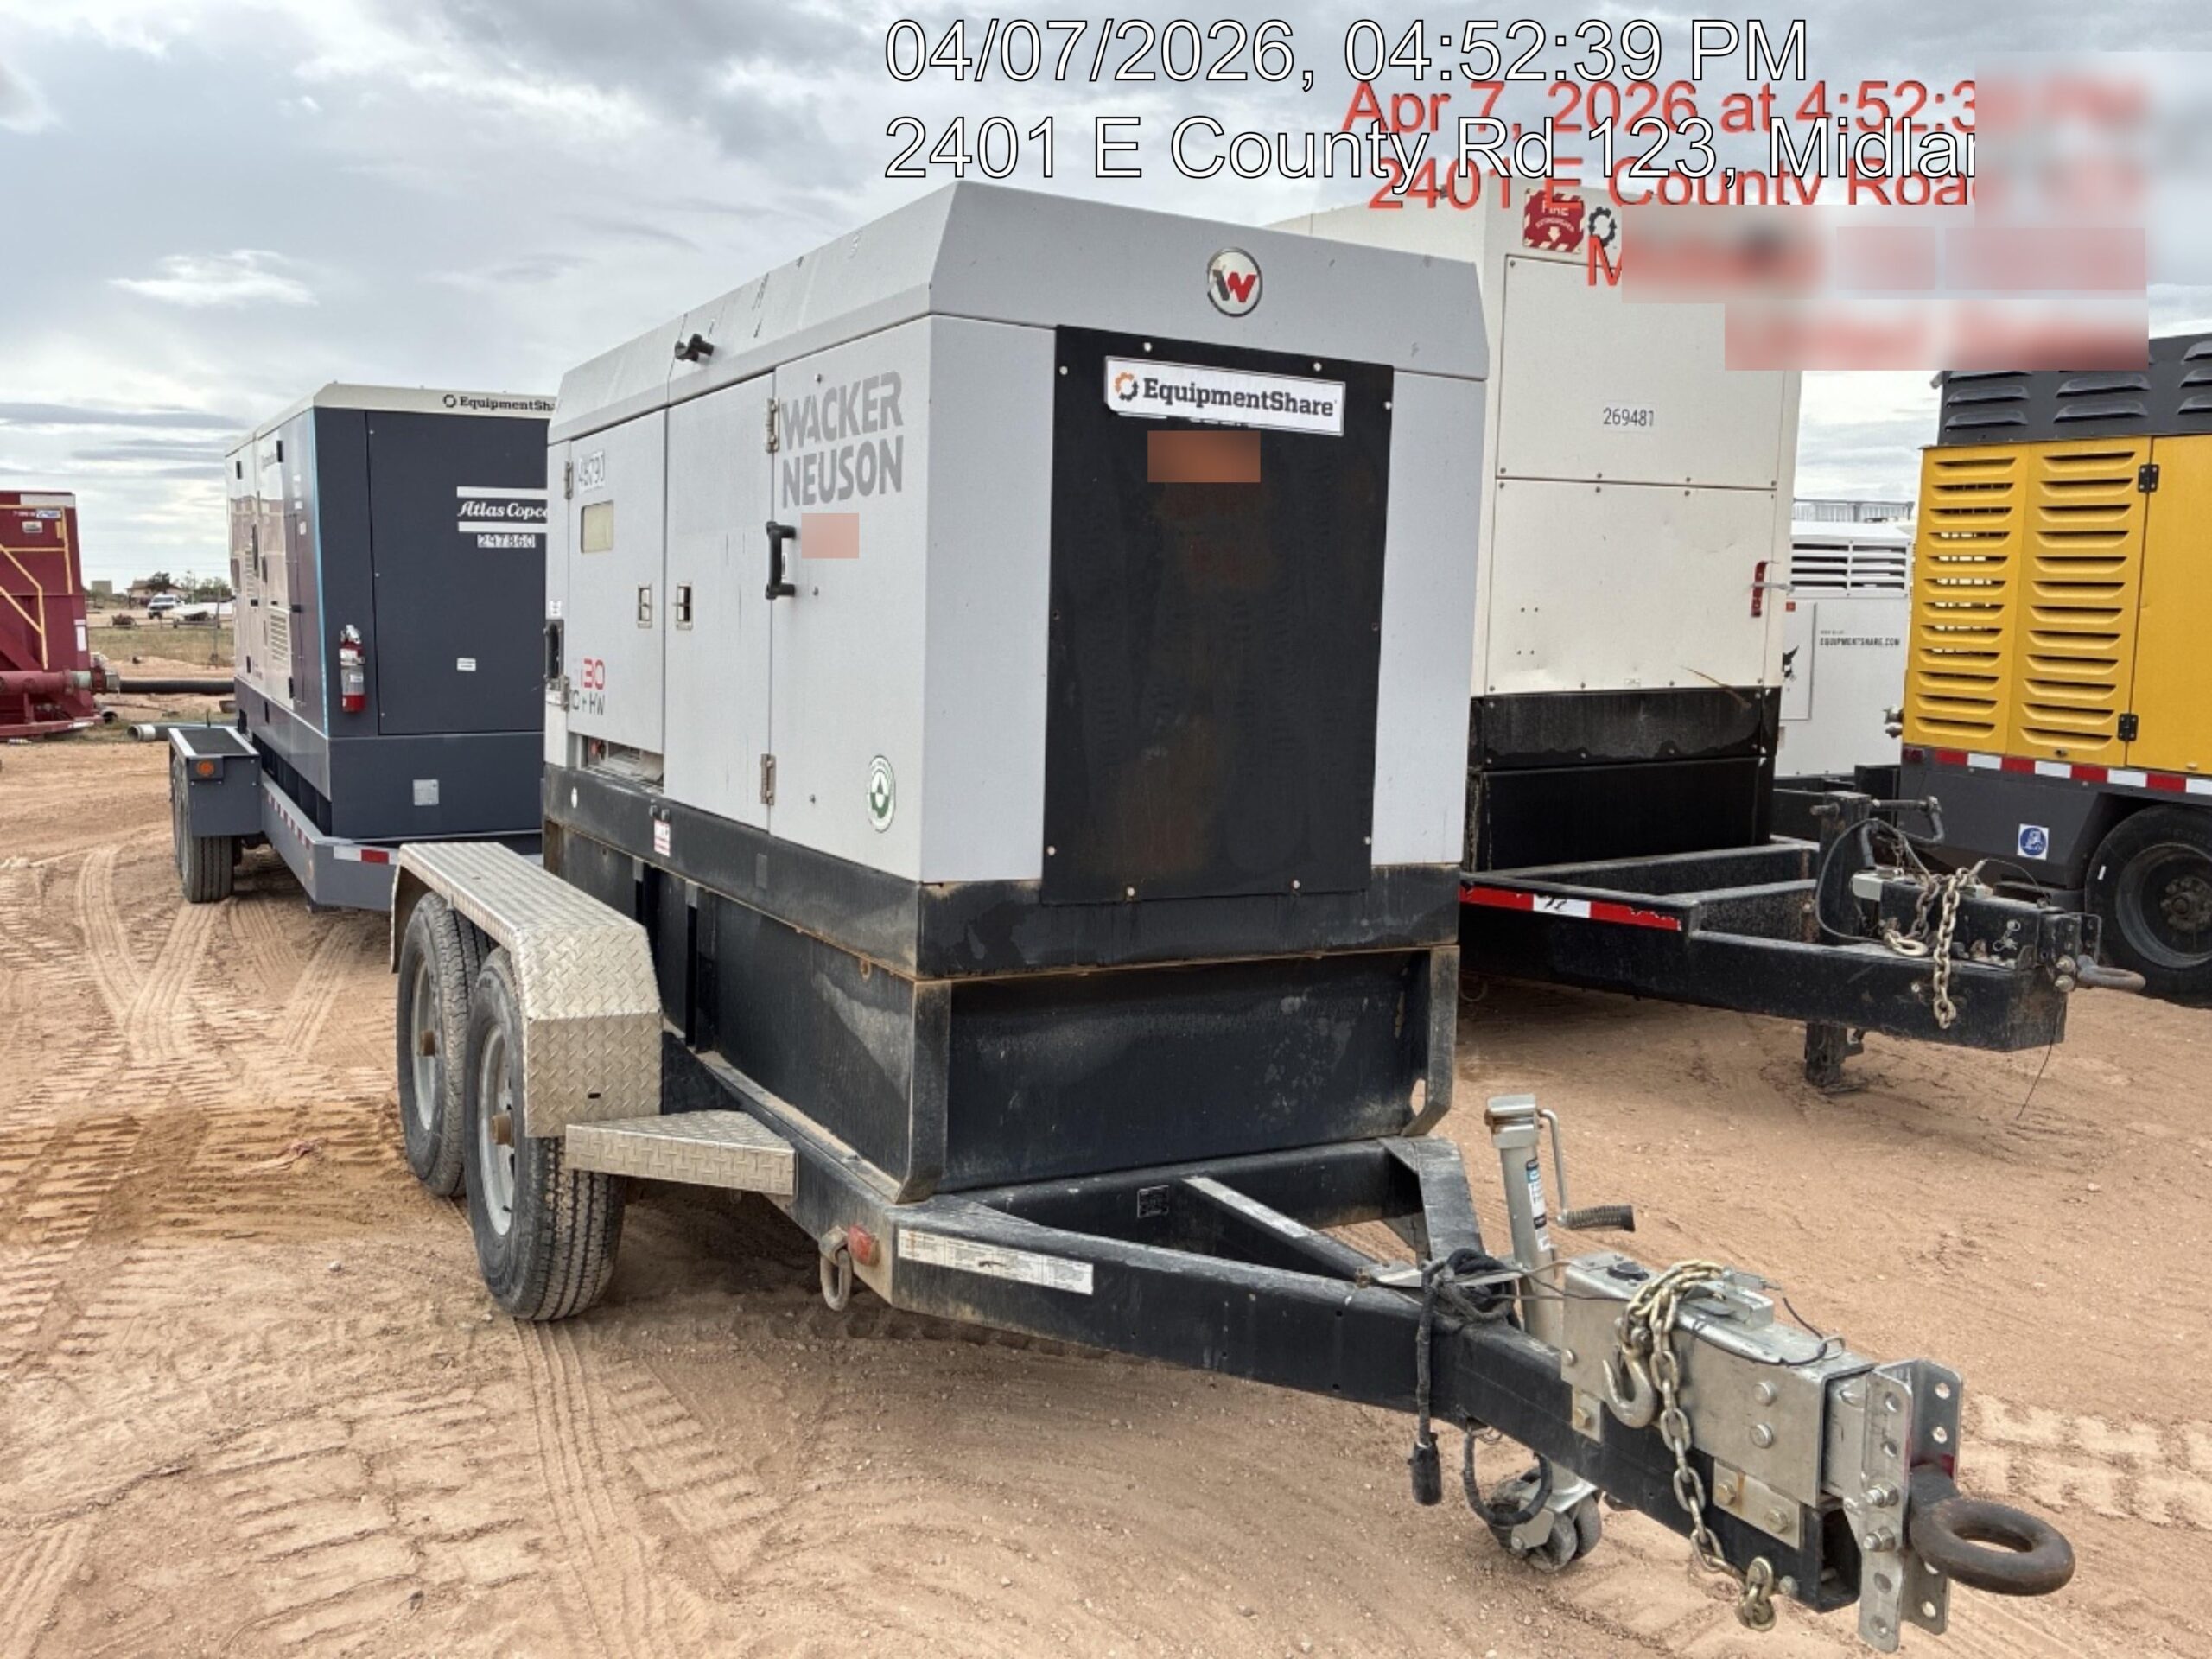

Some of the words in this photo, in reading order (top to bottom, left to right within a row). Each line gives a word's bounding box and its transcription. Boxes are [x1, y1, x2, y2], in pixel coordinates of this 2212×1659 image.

[781, 371, 904, 450] WACKER
[1143, 377, 1333, 417] EquipmentShare
[782, 435, 904, 509] NEUSON
[457, 500, 505, 518] Atlas
